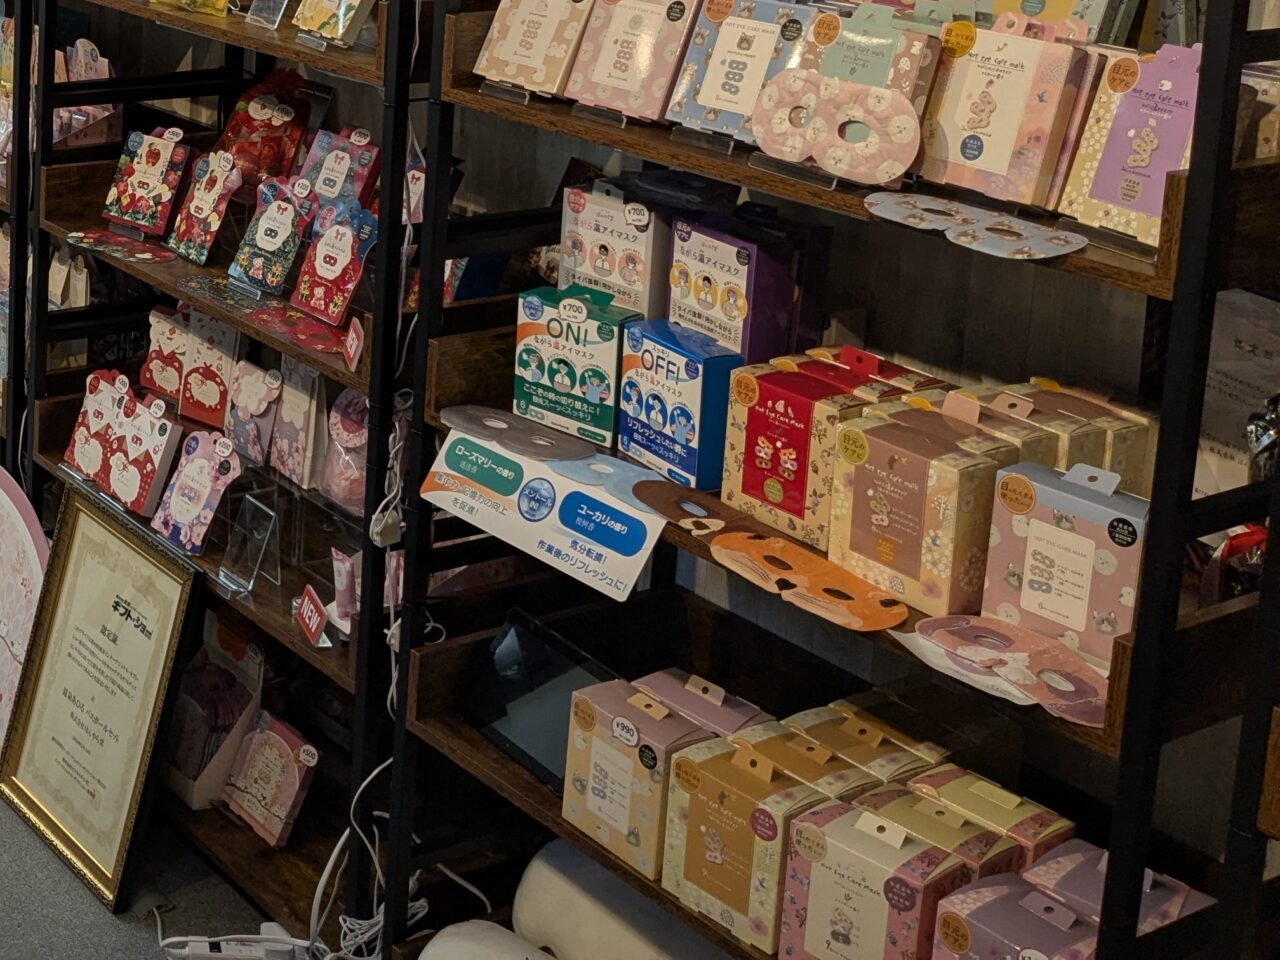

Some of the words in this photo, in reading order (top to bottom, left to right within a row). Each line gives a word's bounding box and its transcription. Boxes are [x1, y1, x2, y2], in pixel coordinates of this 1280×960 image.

[1112, 64, 1136, 77] 目元の
[1110, 77, 1131, 88] ケアに
[628, 208, 645, 216] ¥700
[563, 303, 583, 314] ¥700
[547, 318, 588, 347] ON!
[641, 349, 681, 385] OFF!
[737, 380, 756, 394] 目元の
[520, 401, 526, 409] 6
[844, 434, 865, 449] 目元の
[843, 446, 862, 460] ケアに
[455, 445, 515, 480] ローズマリーの香り
[523, 487, 553, 508] メントール
[577, 503, 628, 535] ユーカリの香り
[570, 539, 608, 565] 気分転換!
[537, 540, 628, 593] 作業後のリフレッシュに!
[301, 595, 321, 634] NEW
[616, 721, 634, 737] ¥990
